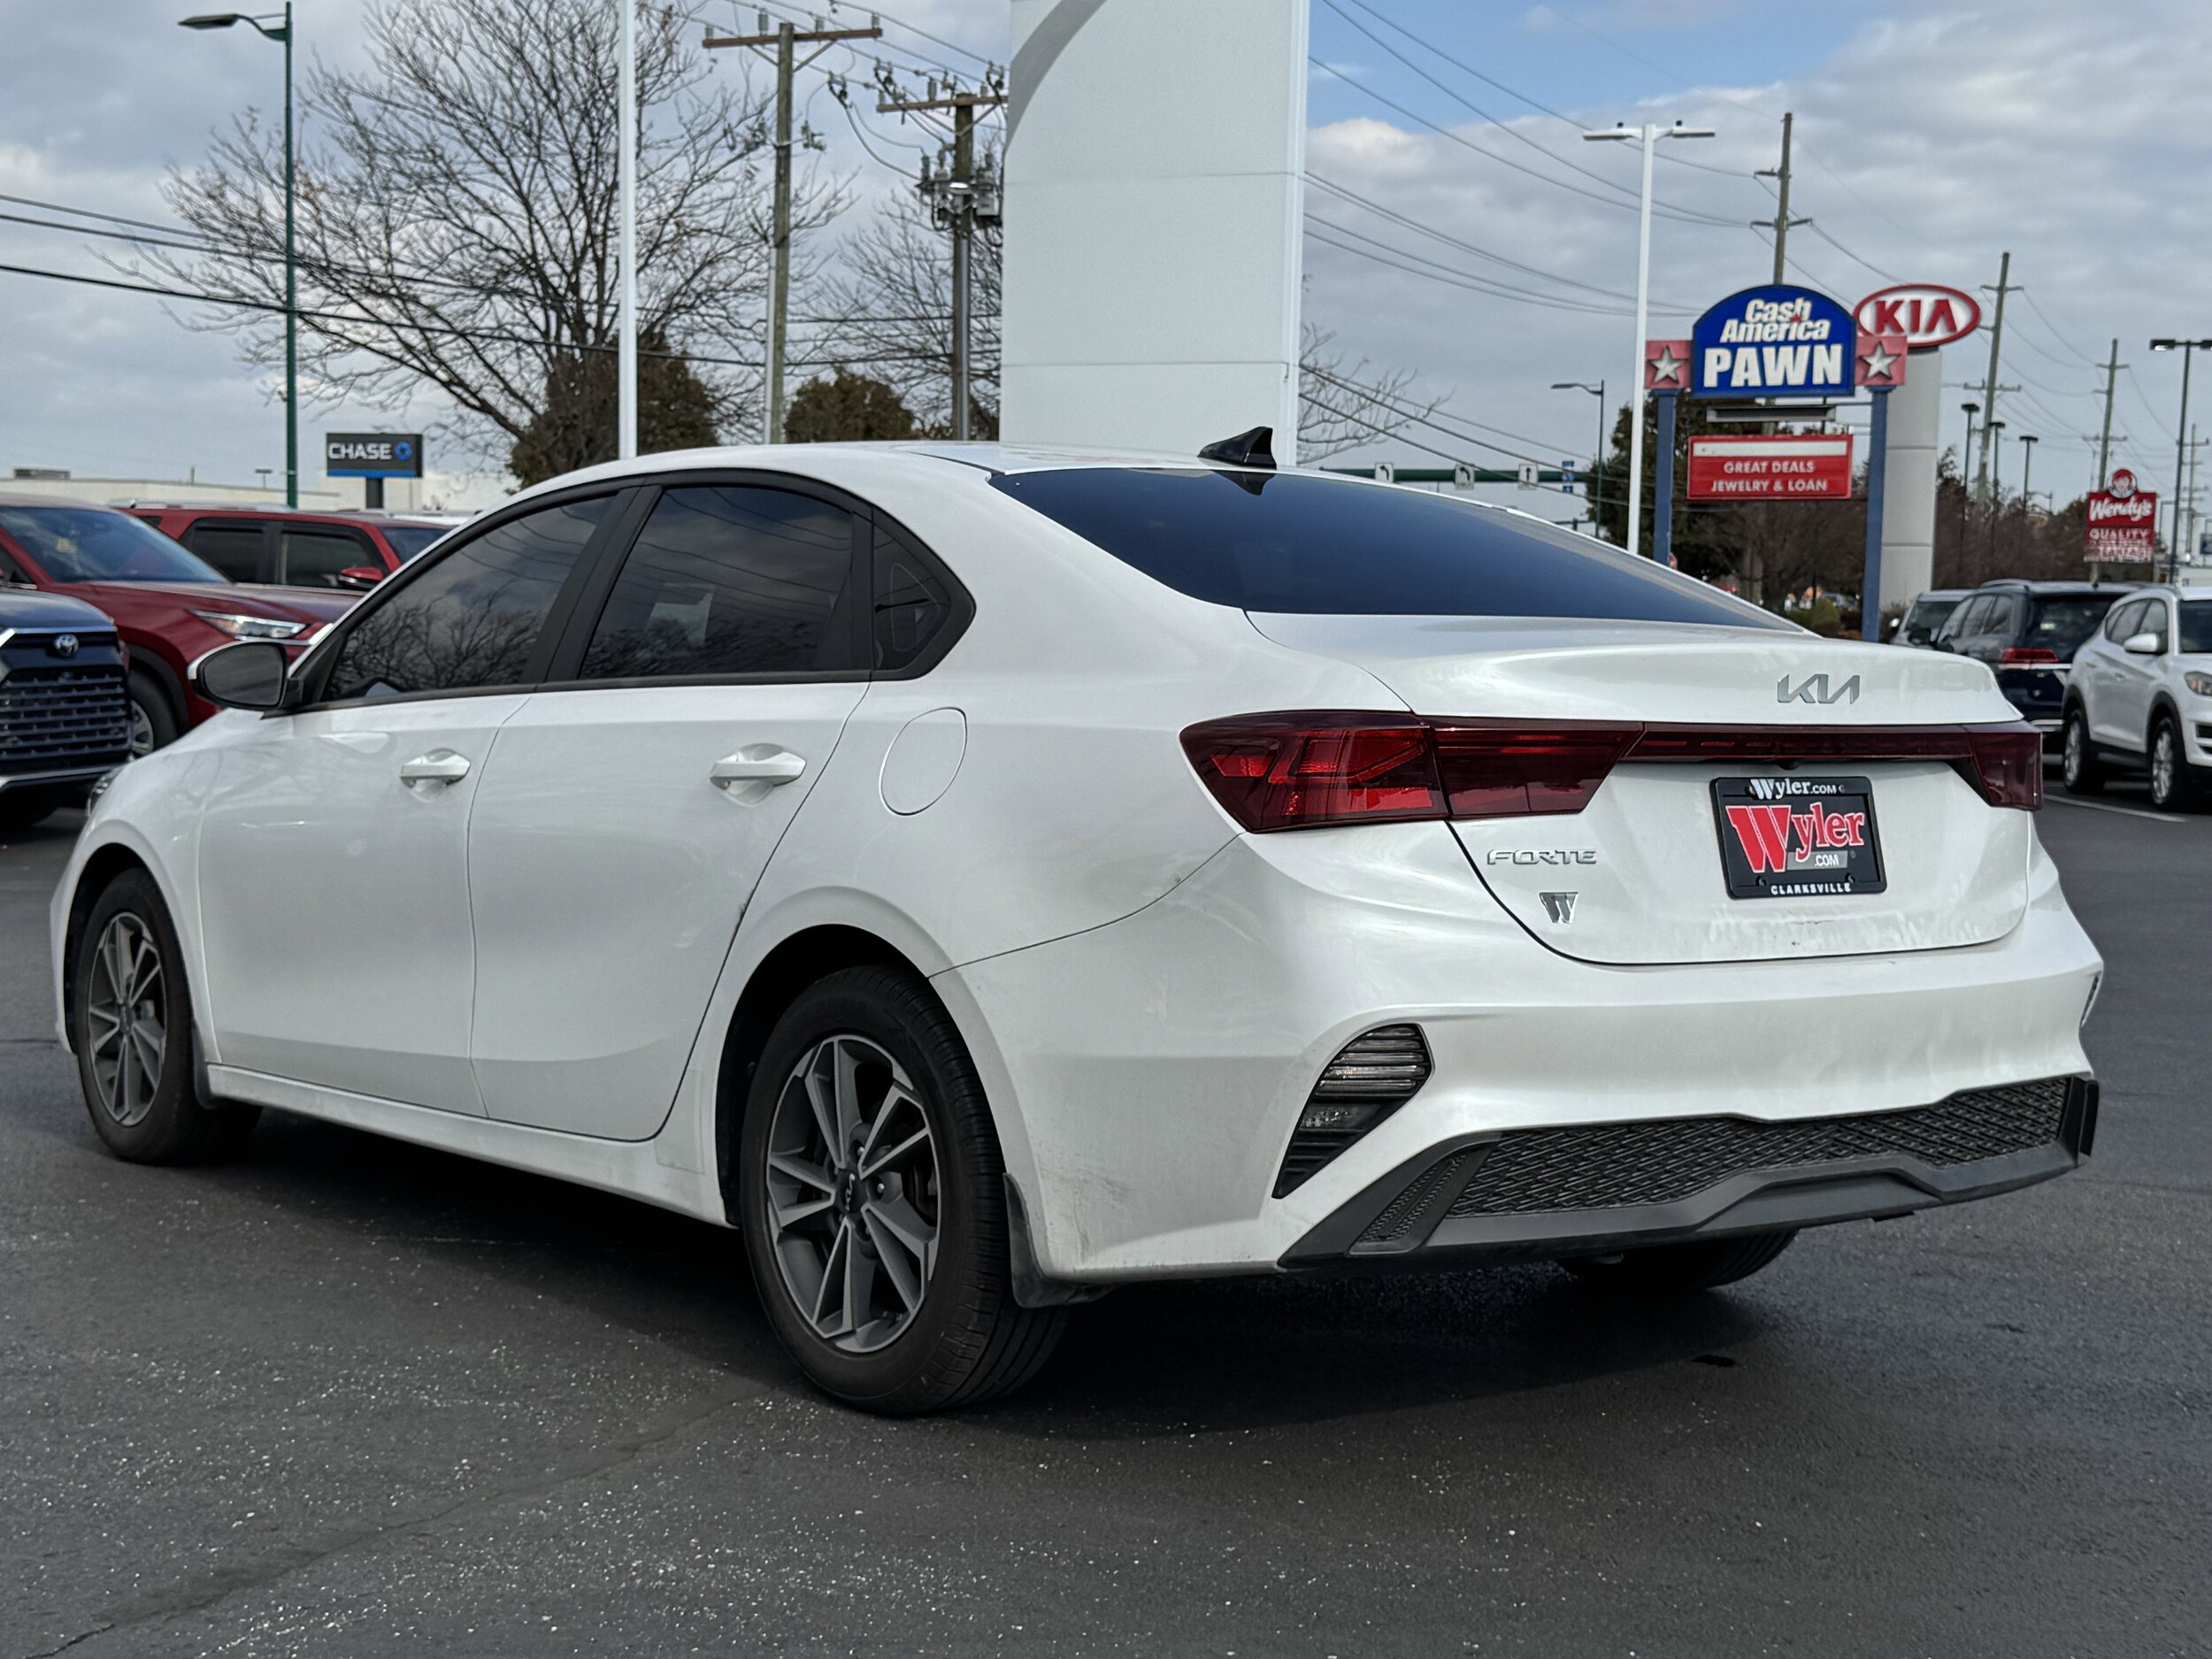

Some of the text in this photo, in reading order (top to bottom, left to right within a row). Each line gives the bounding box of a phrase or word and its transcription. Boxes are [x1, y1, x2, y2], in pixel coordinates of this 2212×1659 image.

[1744, 297, 1812, 323] Cash
[1874, 299, 1957, 334] KIA
[1720, 319, 1831, 343] America
[1703, 344, 1843, 388] PAWN
[328, 442, 393, 459] CHASE
[1724, 460, 1816, 473] GREAT DEALS
[1710, 479, 1828, 493] JEWELRY & LOAN
[2089, 496, 2153, 522] Wendy's
[2089, 528, 2149, 541] QUALITY
[1777, 673, 1861, 705] KIA
[1725, 802, 1865, 873] Wyler
[1486, 849, 1597, 865] FORTE
[1770, 882, 1852, 895] CLARKSVILLE
